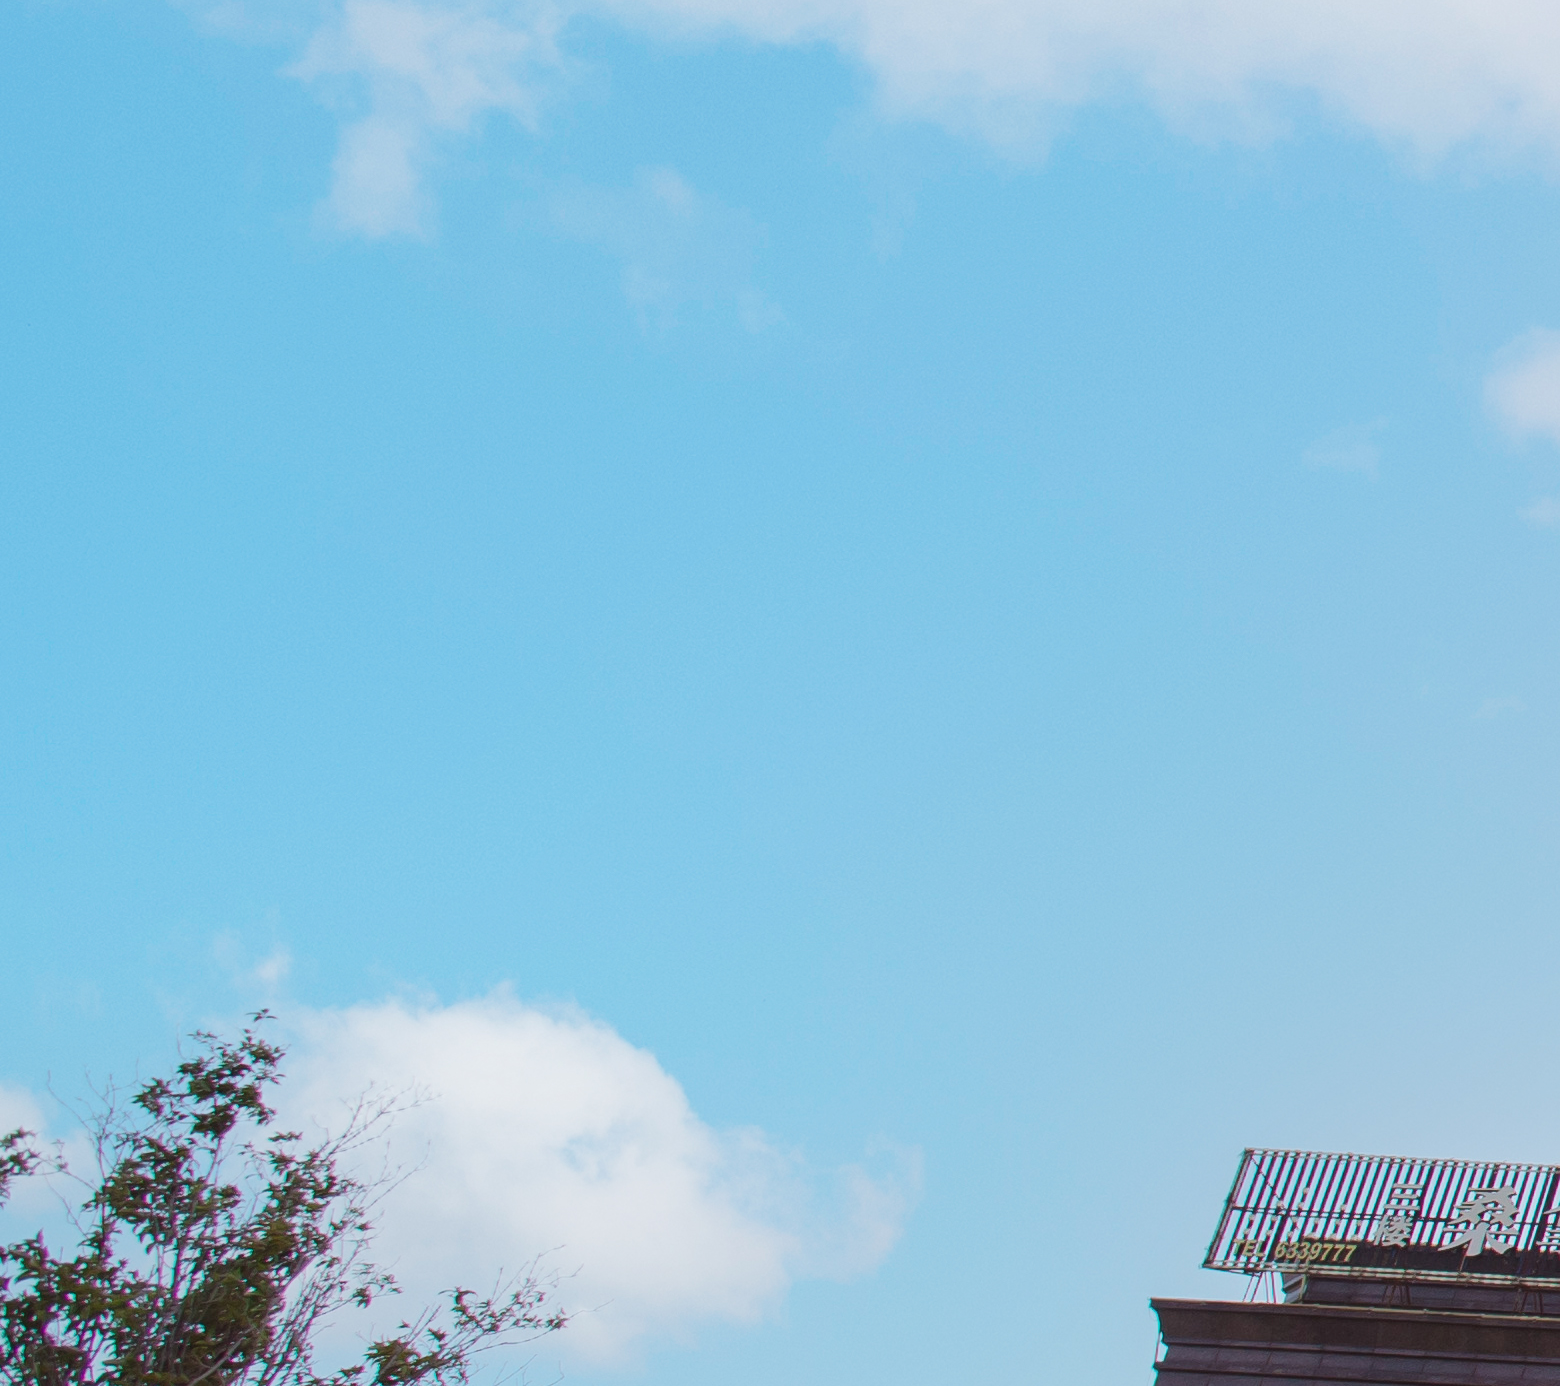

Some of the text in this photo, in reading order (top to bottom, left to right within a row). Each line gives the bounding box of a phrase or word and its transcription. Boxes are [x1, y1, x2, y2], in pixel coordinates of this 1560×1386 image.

[1374, 1182, 1424, 1248] 三楼
[1232, 1238, 1358, 1263] TEL 6339777
